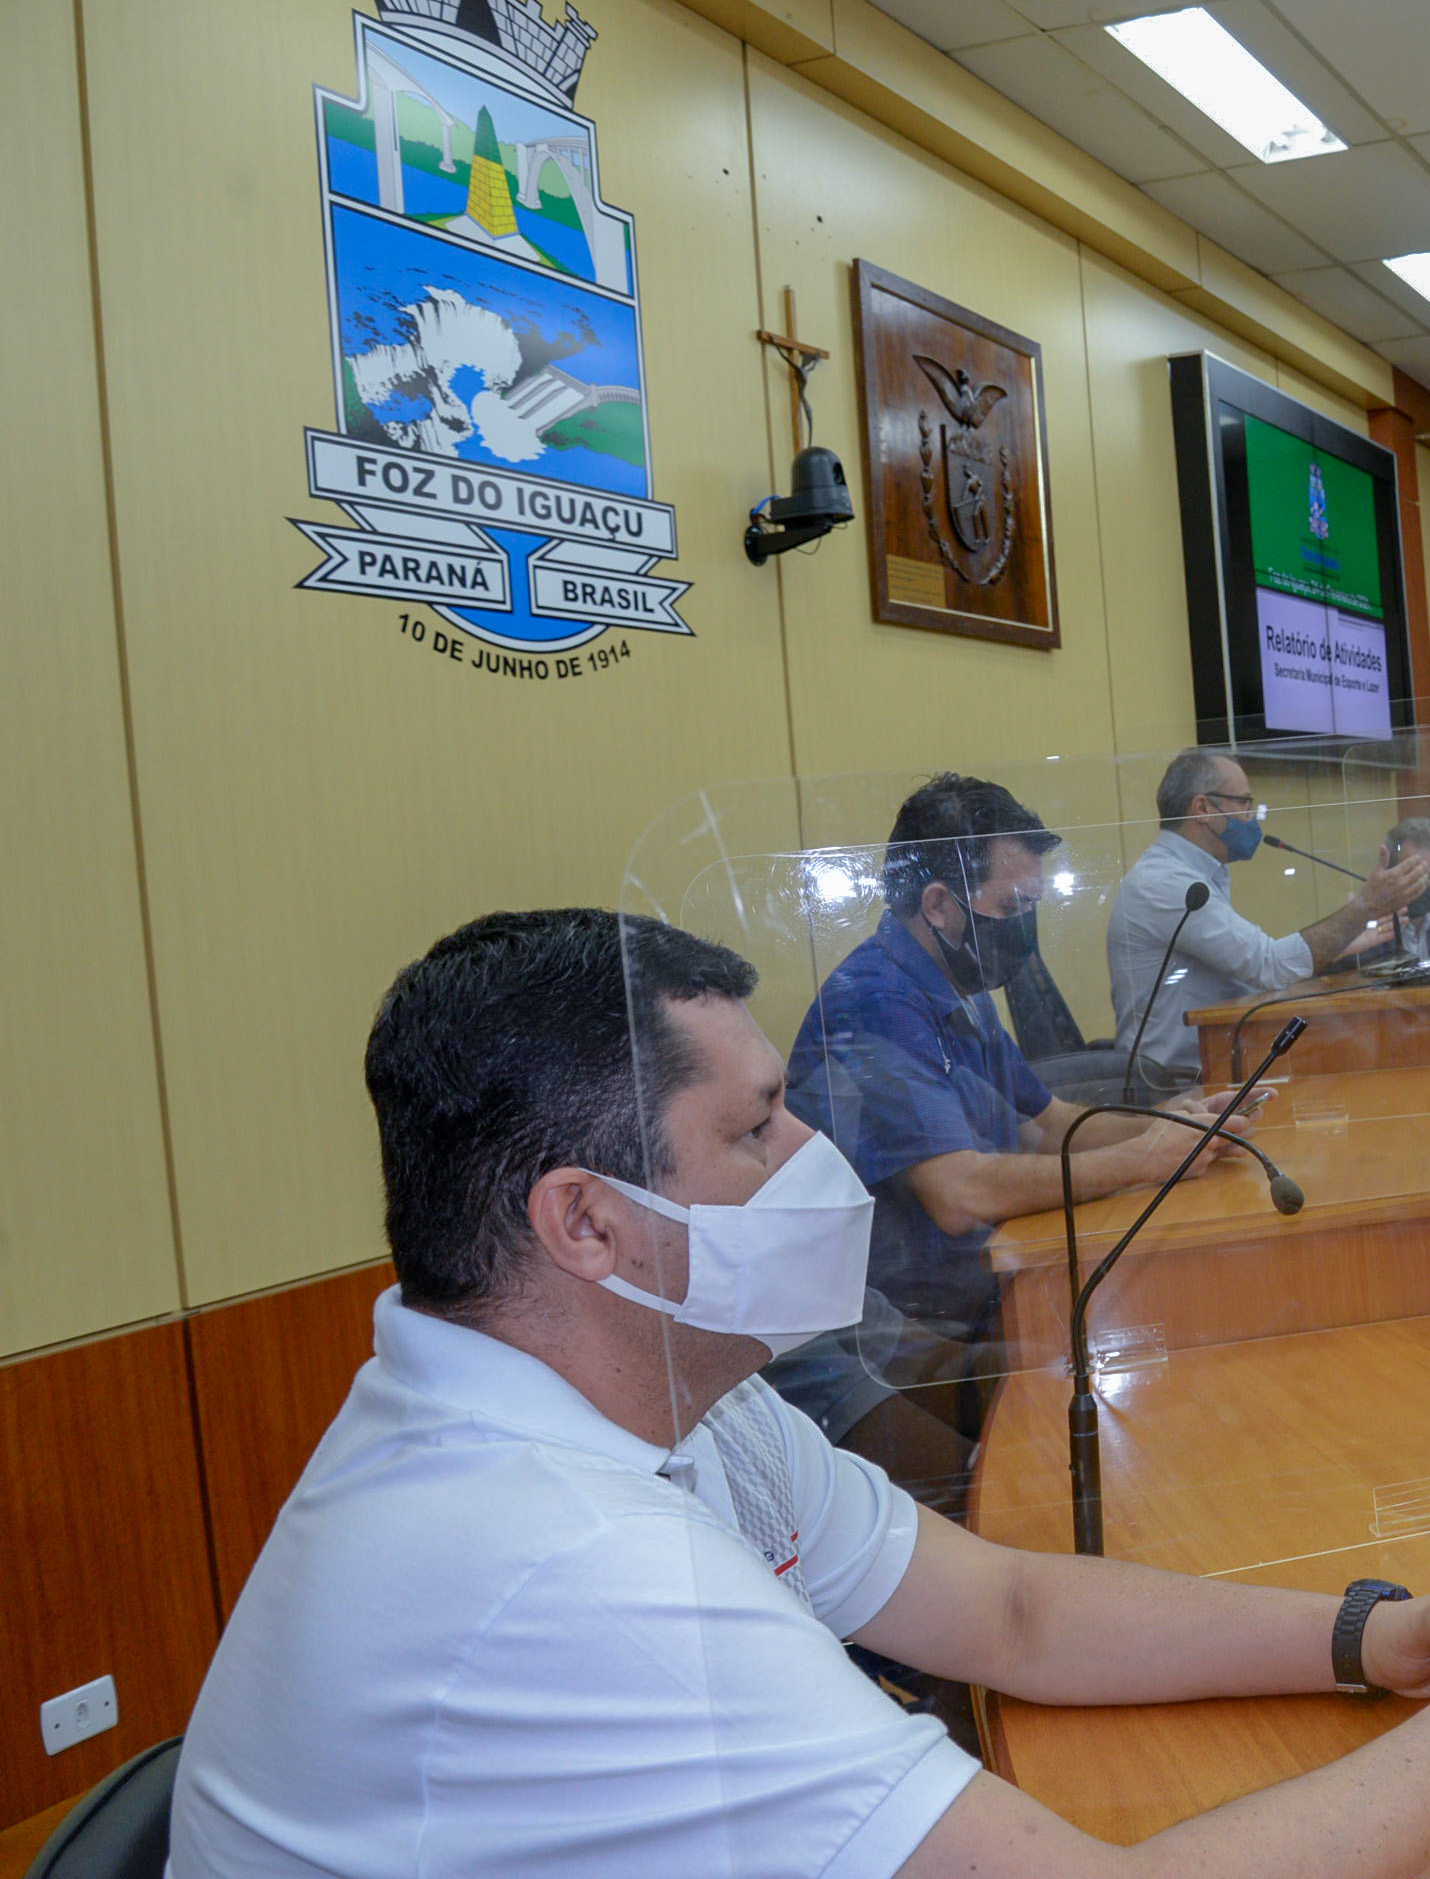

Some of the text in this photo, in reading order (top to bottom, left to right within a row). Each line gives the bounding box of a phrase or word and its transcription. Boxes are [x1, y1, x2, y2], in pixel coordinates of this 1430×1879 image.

[356, 455, 645, 541] FOZ DO IGUAÇU
[357, 550, 490, 592] PARANÁ
[562, 579, 655, 614] BRASIL
[398, 613, 632, 680] 10 DE JUNHO DE 1914
[1266, 625, 1382, 672] Relatório de Atividades
